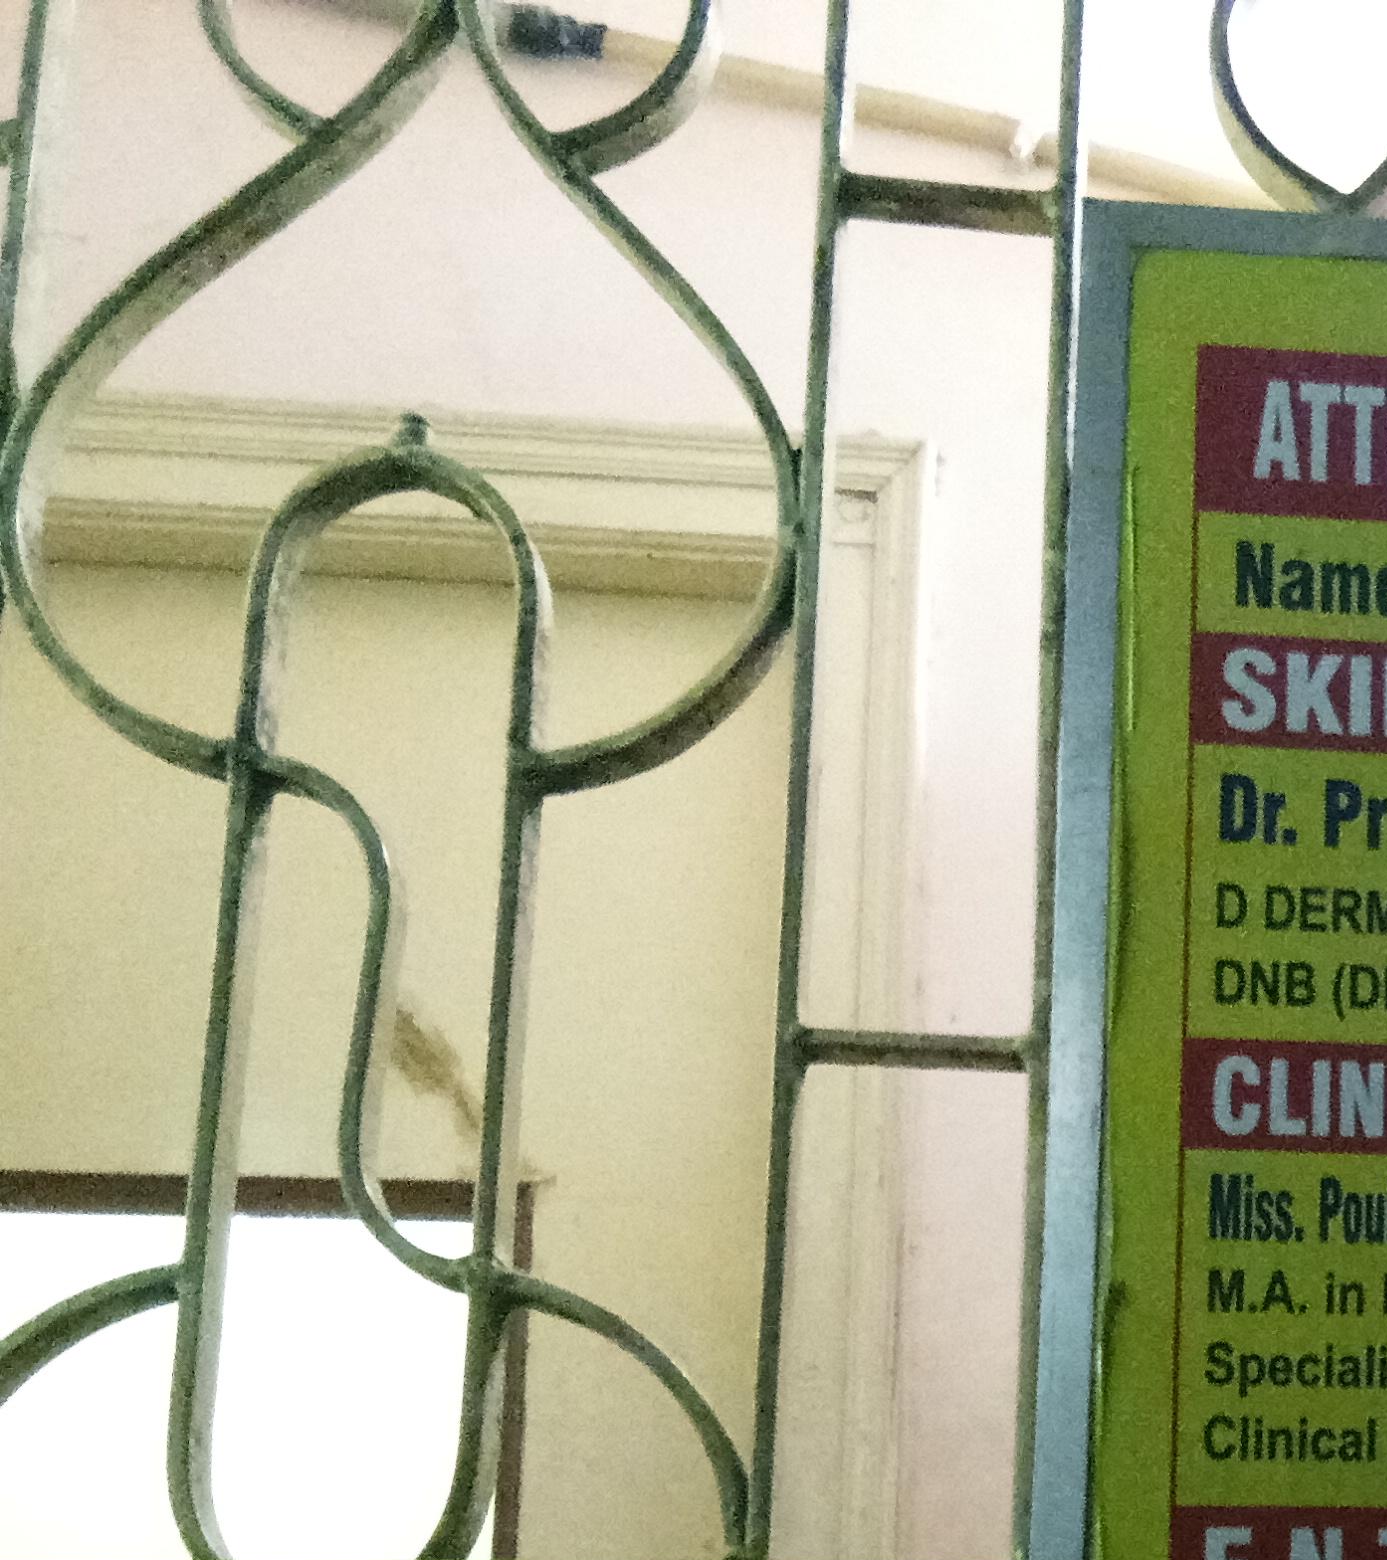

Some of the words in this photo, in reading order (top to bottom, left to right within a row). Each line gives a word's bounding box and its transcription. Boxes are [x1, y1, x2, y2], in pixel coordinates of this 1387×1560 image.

[1218, 773, 1297, 845] Dr.
[1215, 882, 1248, 929] D
[1214, 960, 1315, 1007] DNB
[1208, 1172, 1304, 1242] Miss.
[1206, 1269, 1307, 1314] M.A.
[1325, 1271, 1364, 1315] in
[1203, 1414, 1376, 1463] Clinical
